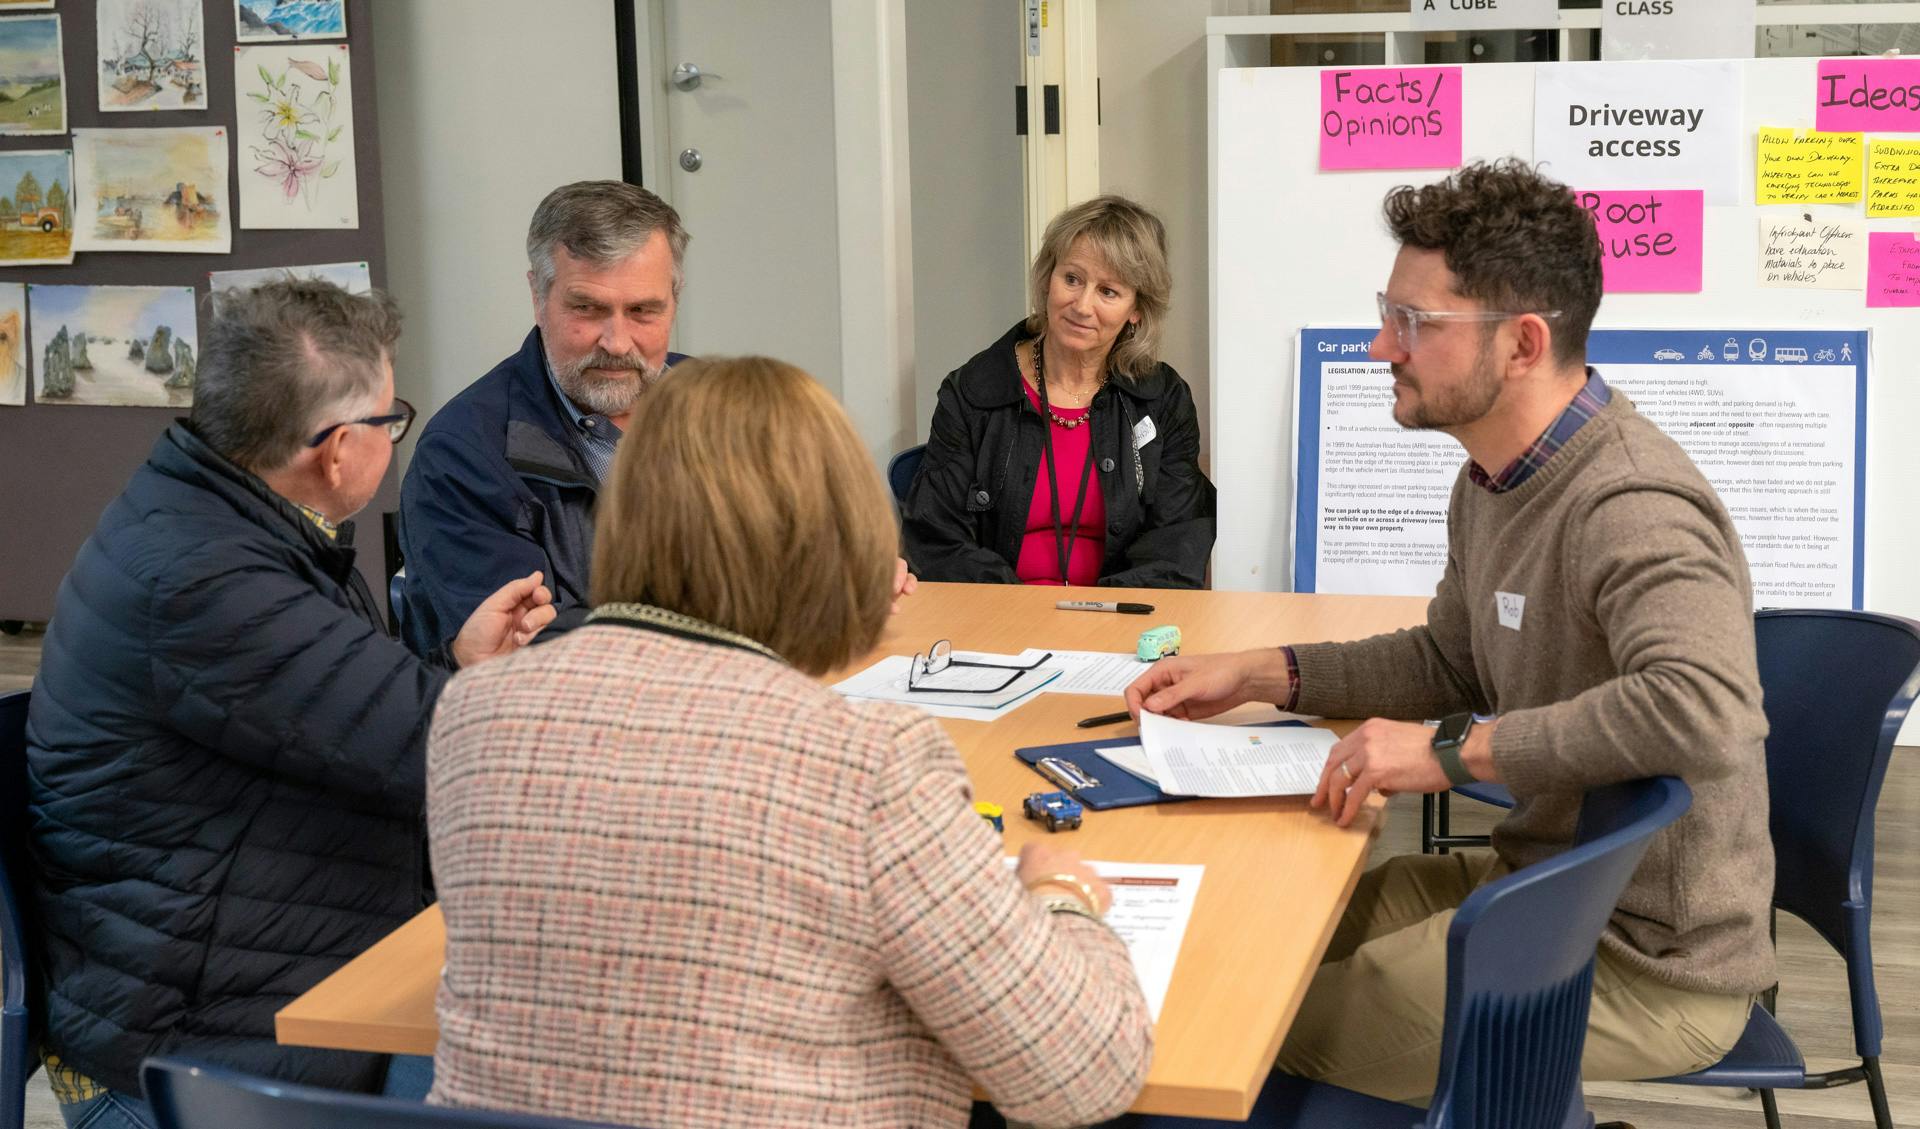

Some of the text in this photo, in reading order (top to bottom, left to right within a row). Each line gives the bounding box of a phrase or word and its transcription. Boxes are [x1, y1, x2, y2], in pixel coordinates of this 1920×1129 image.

[1423, 0, 1498, 11] A CUBE
[1616, 1, 1674, 16] CLASS
[1335, 72, 1444, 107] Facts/
[1820, 73, 1920, 112] Ideas
[1568, 103, 1704, 132] Driveway
[1323, 109, 1443, 146] Opinions
[1588, 138, 1682, 158] access
[1873, 144, 1920, 156] SUBDIVISIO
[1582, 192, 1662, 225] Root
[1600, 232, 1677, 259] use
[1764, 243, 1839, 257] have education
[1817, 259, 1846, 274] place
[1783, 270, 1817, 283] vehicles
[1317, 340, 1371, 355] Car parki
[1327, 367, 1366, 375] LEGISLATION
[1689, 420, 1716, 429] adjacent
[1728, 420, 1755, 429] opposite
[1347, 506, 1361, 515] park
[1387, 507, 1402, 516] edge
[1415, 508, 1444, 517] driveway,
[1379, 524, 1404, 533] property.
[1401, 516, 1428, 525] driveway
[1428, 516, 1445, 526] (even
